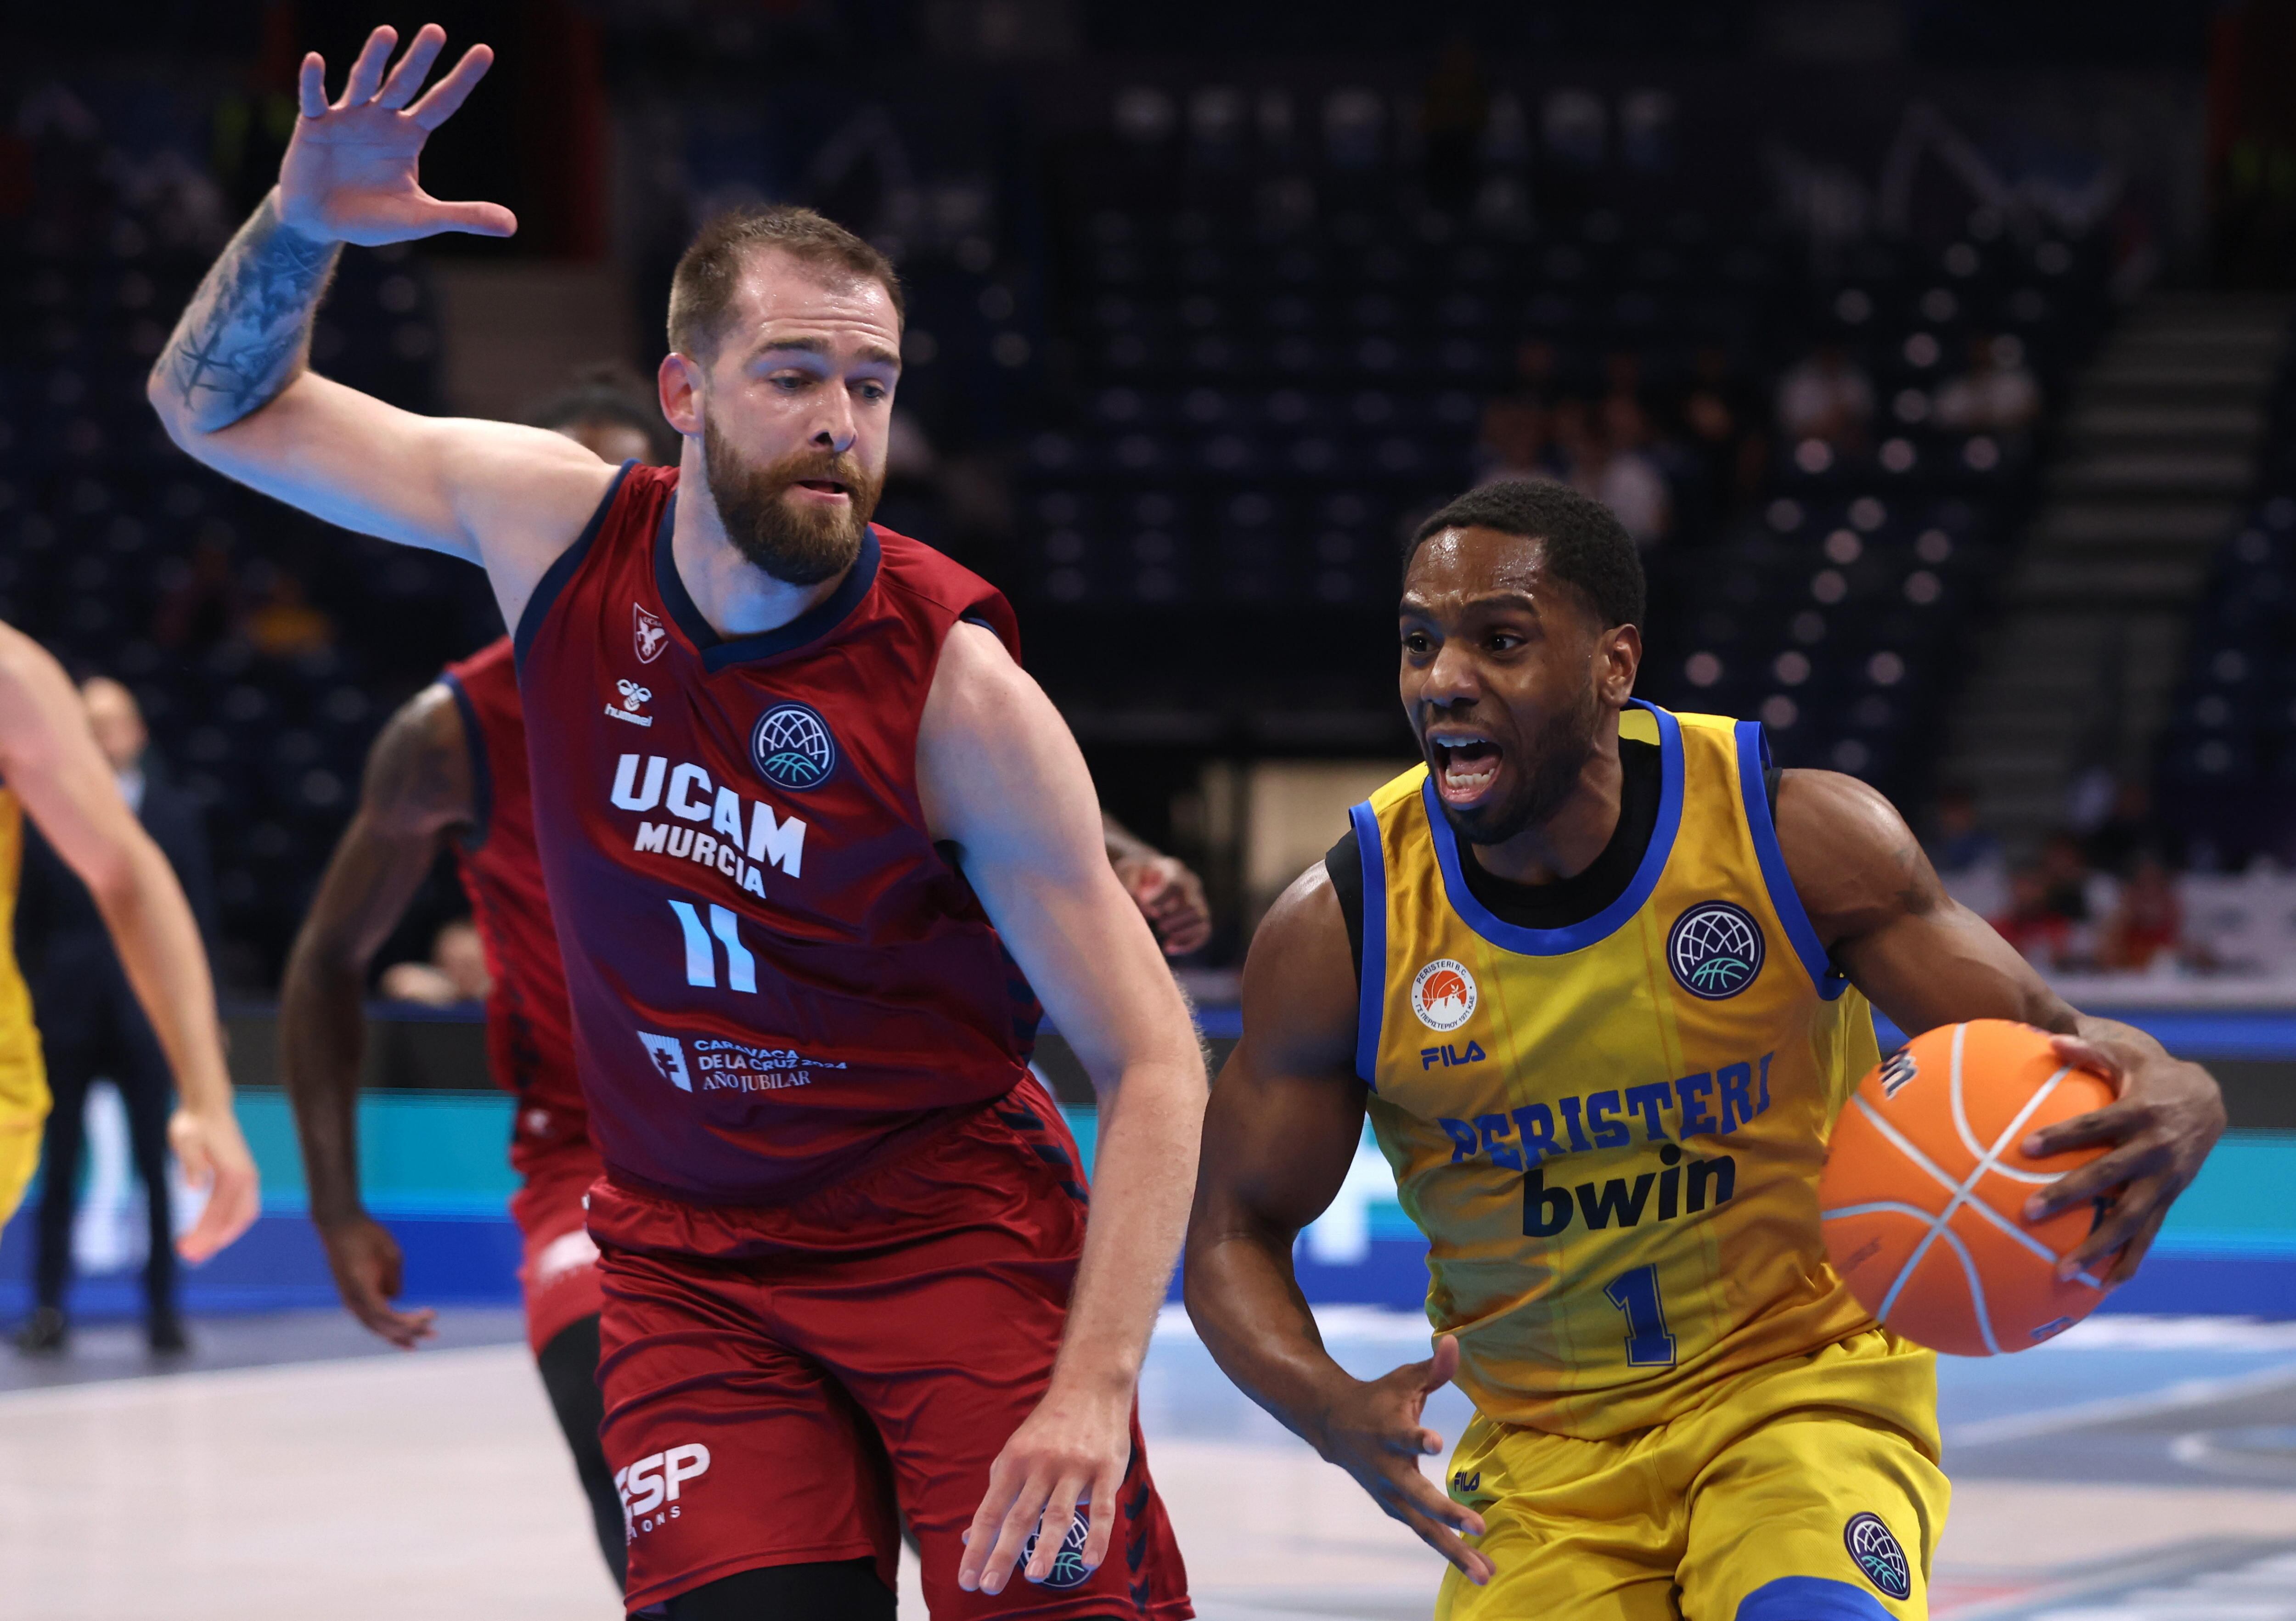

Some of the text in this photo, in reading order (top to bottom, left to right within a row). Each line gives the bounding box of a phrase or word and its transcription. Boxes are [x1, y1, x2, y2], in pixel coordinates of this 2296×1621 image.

[604, 703, 653, 727] hummel
[610, 754, 807, 878] UCAM
[633, 822, 766, 899] MURCIA
[668, 900, 757, 994] 11
[1416, 960, 1467, 984] PERISTERI B.C.
[1420, 1012, 1458, 1030] ΠΕΡΙΣΤΕΡΙΟΥ
[1458, 1010, 1470, 1023] 1971
[694, 1040, 799, 1059] CARAVACA
[1420, 1040, 1486, 1071] FILA
[749, 1058, 798, 1071] CRUZ
[703, 1070, 811, 1093] AÑO JUBILAR
[1437, 1051, 1774, 1172] PERISTERI
[1523, 1143, 1736, 1238] bwin
[1603, 1263, 1677, 1368] 1
[1454, 1471, 1480, 1492] FILA
